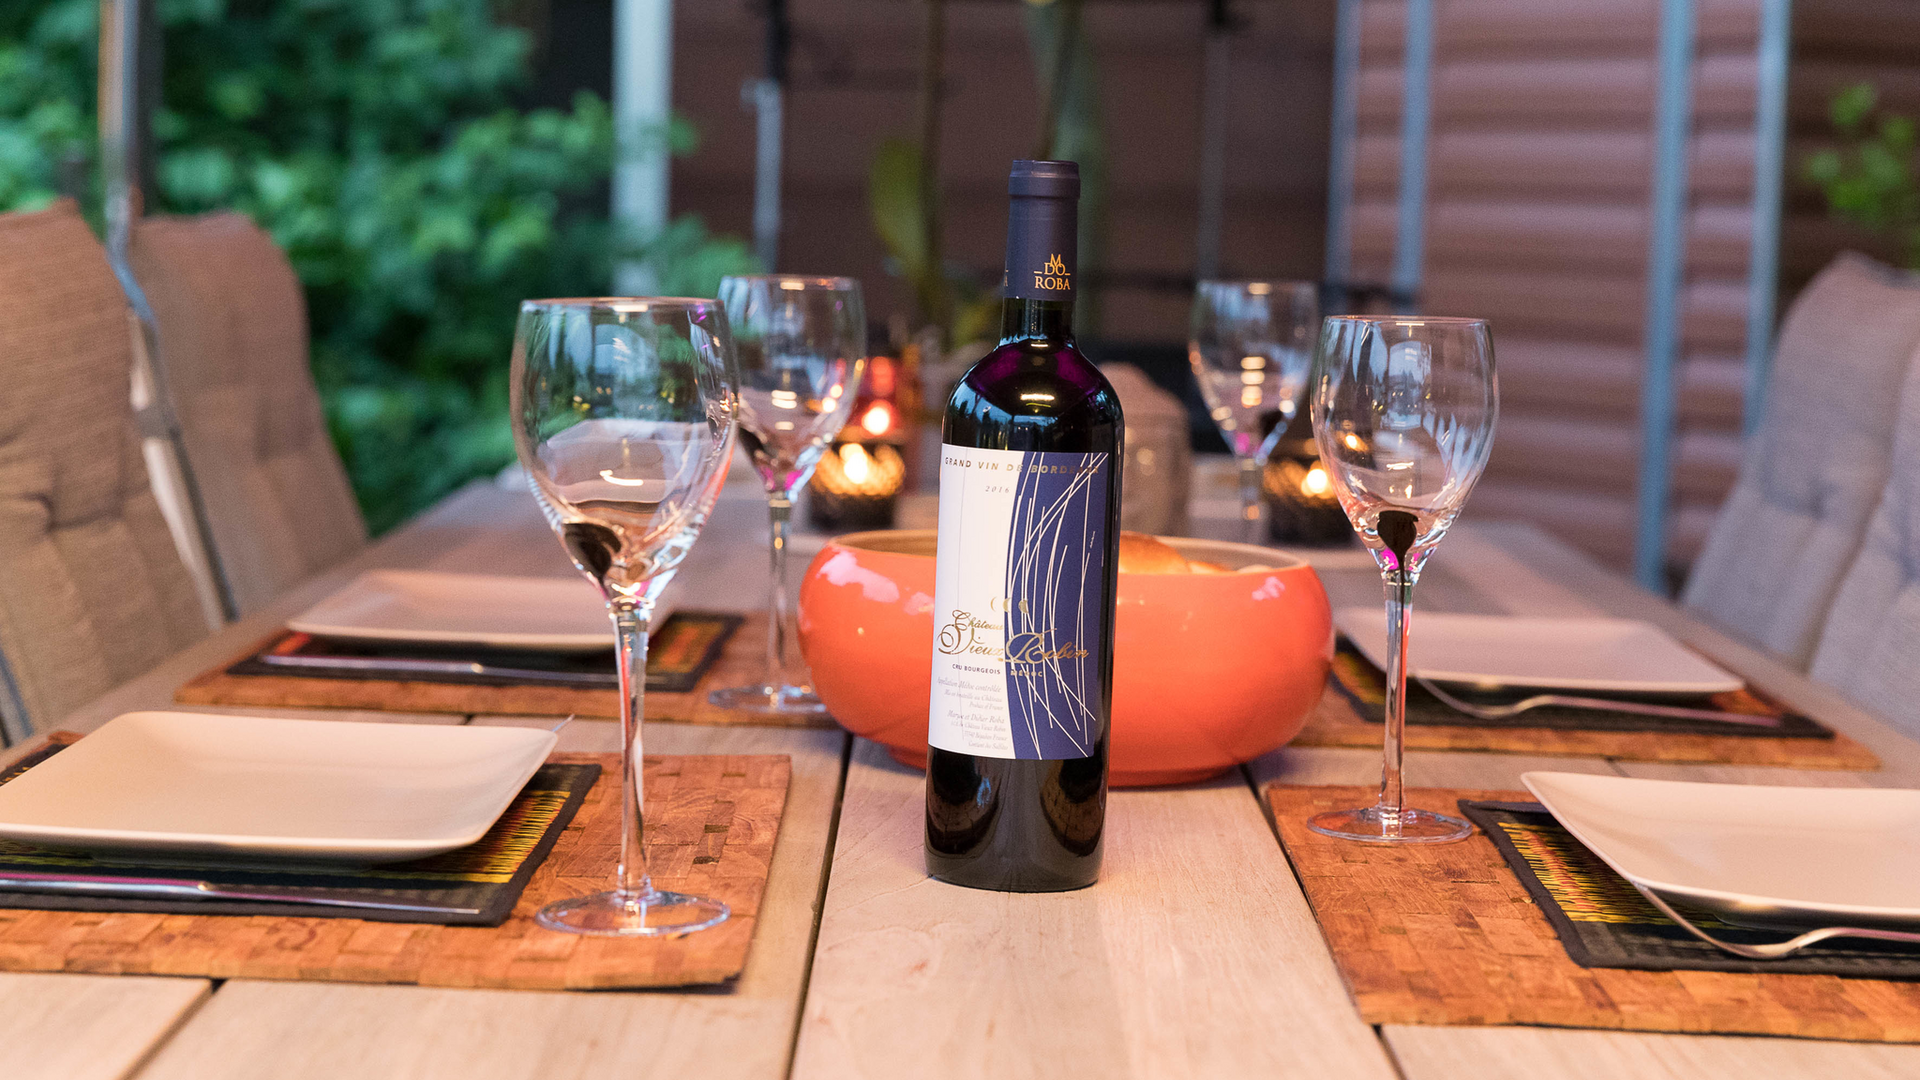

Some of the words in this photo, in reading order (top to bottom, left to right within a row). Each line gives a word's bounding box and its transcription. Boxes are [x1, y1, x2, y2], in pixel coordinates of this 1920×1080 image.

[1034, 275, 1071, 290] ROBA
[945, 457, 972, 468] GRAND
[978, 461, 999, 471] VIN
[1006, 463, 1024, 473] DE
[985, 485, 1011, 494] 2016
[951, 609, 1003, 632] Château
[936, 623, 1004, 655] Vieux
[997, 628, 1090, 664] Robin
[952, 663, 963, 671] CRU
[964, 665, 1001, 675] BOURGEOIS
